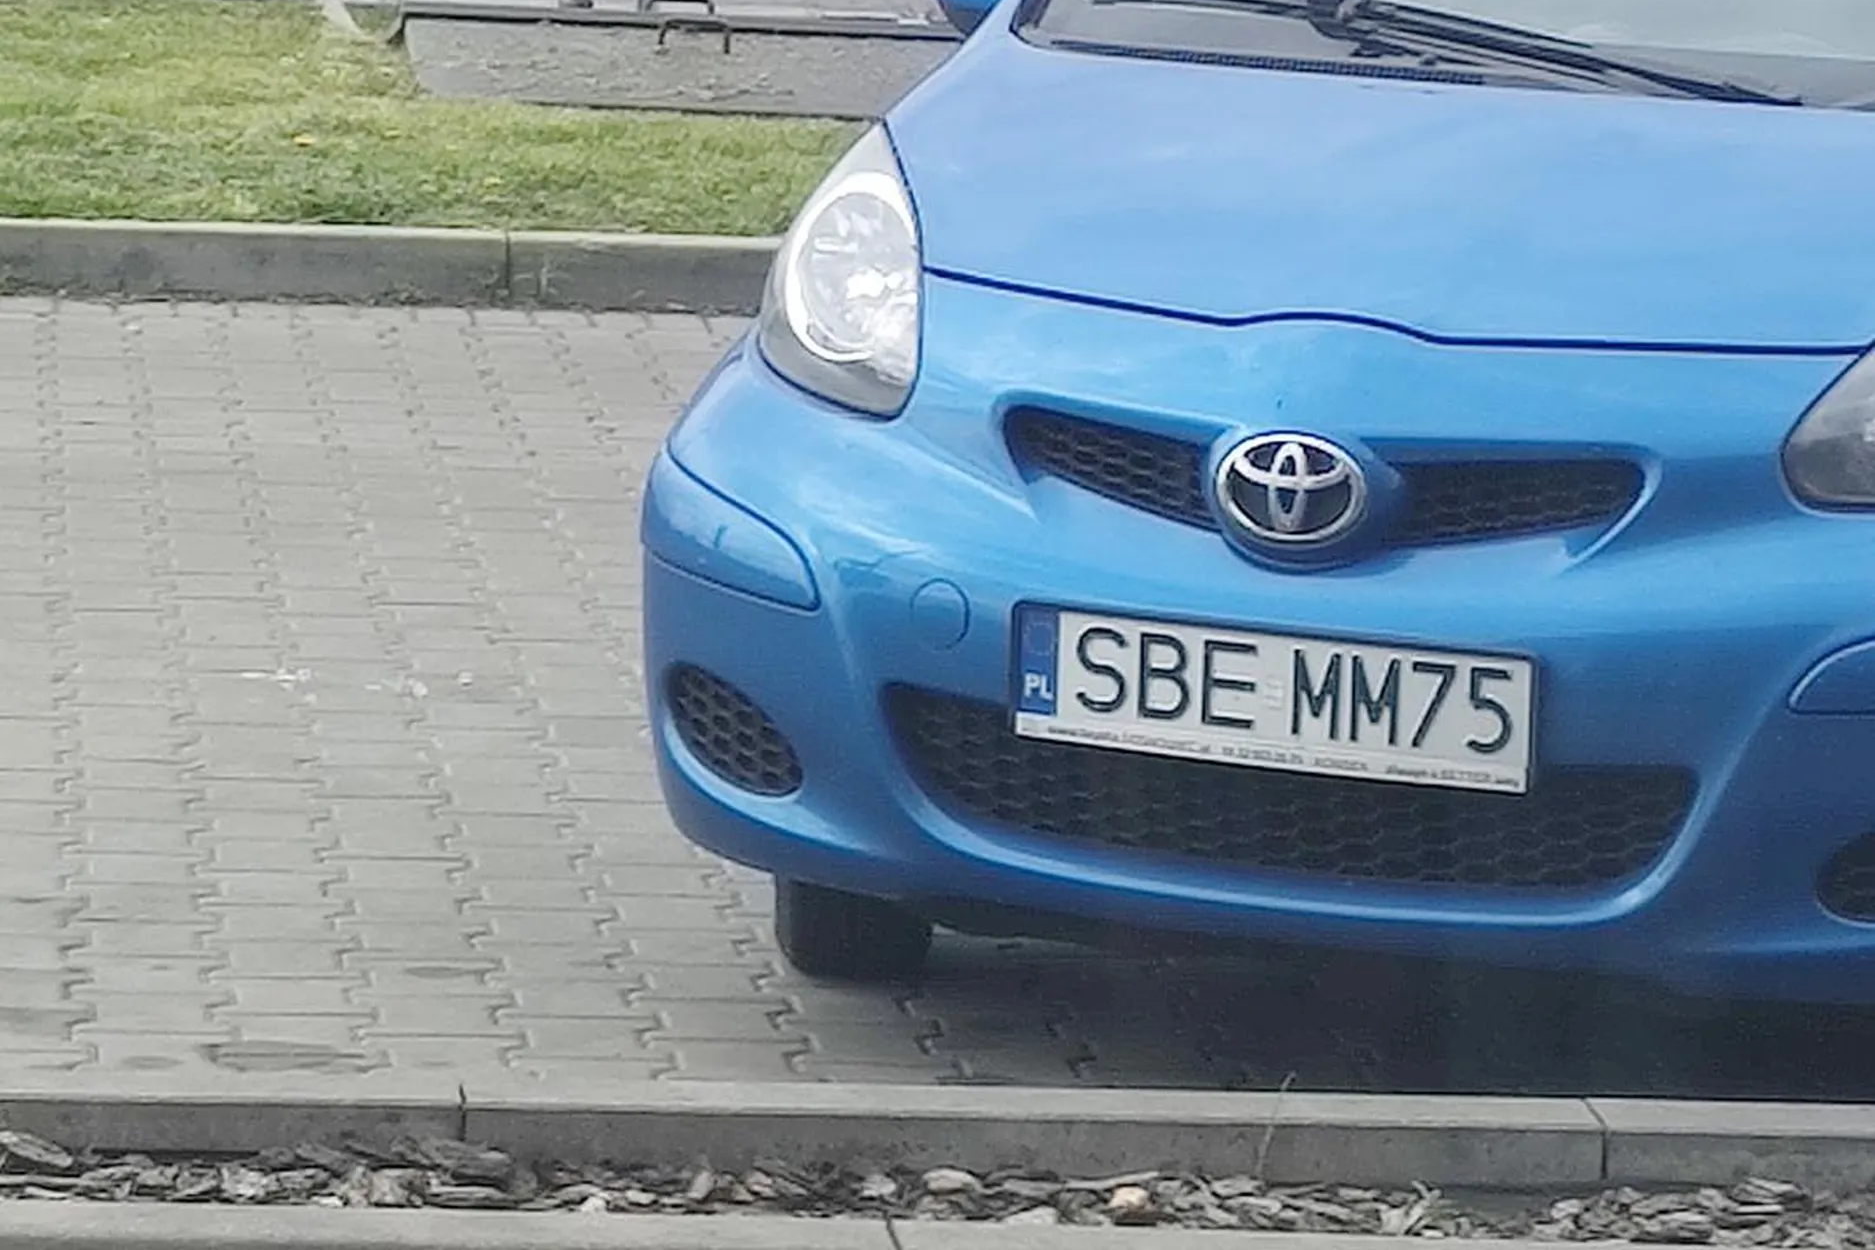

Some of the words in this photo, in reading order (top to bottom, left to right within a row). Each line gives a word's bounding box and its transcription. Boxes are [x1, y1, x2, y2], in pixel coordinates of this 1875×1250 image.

[1024, 671, 1054, 700] PL
[1075, 625, 1259, 730] SBE
[1290, 648, 1514, 755] MM75
